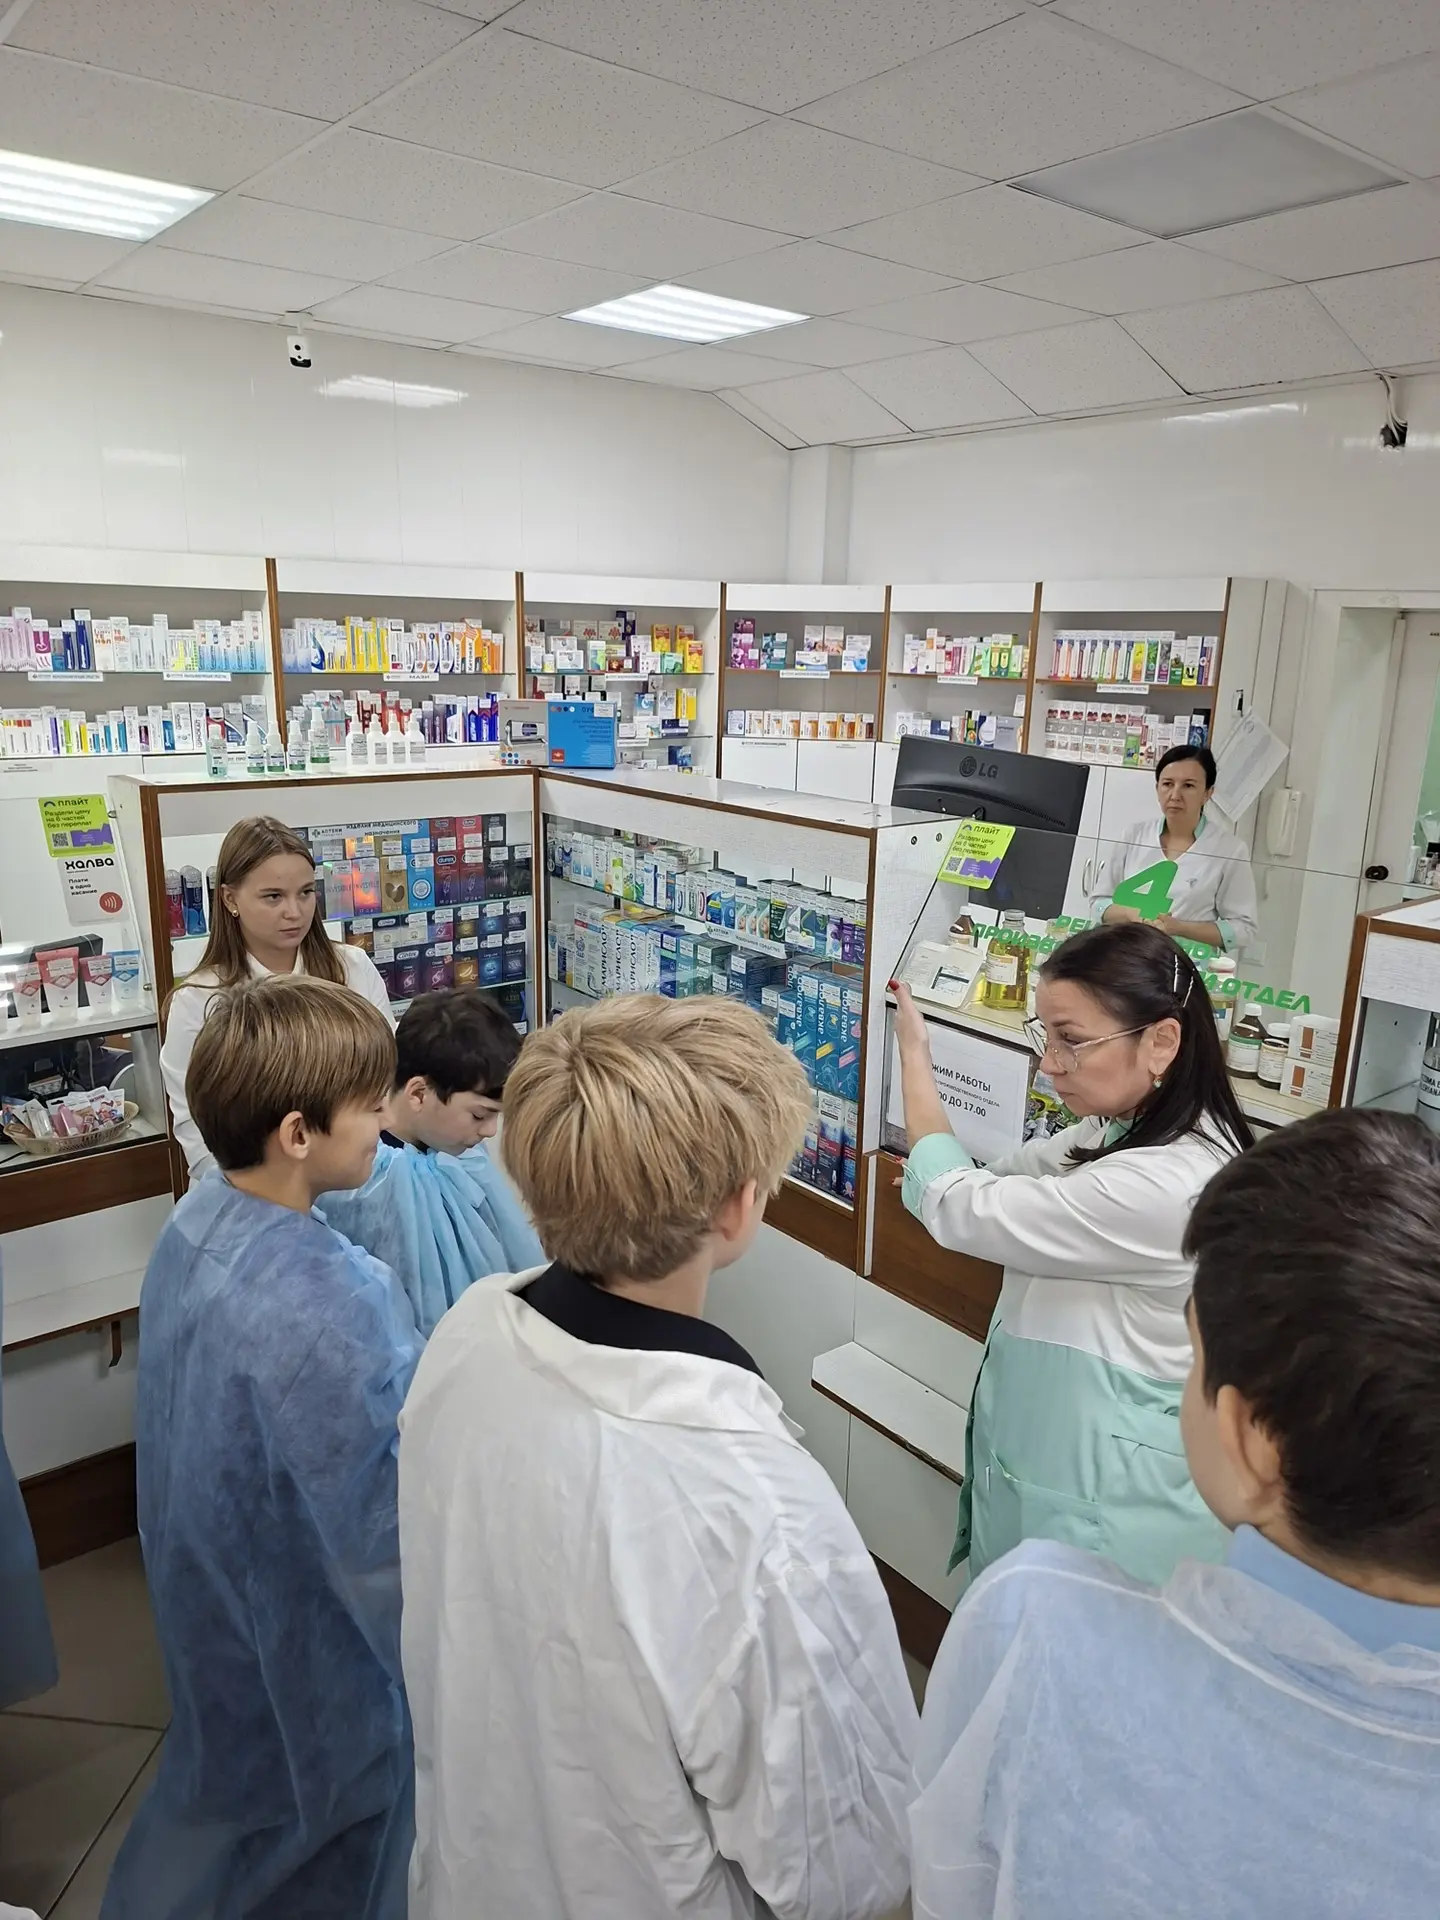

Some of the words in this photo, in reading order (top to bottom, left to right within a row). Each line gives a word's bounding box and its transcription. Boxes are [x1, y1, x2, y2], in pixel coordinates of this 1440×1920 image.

[978, 762, 999, 779] LG
[57, 798, 89, 807] плайт
[75, 808, 91, 816] цену
[974, 825, 1000, 835] плайт
[1112, 860, 1179, 921] 4
[972, 923, 1065, 955] ПРОИЗВ
[1222, 977, 1311, 1014] ОТДЕЛ
[840, 990, 849, 1043] аквалор
[932, 1063, 954, 1079] ЖИМ
[955, 1072, 991, 1092] РАБОТЫ
[948, 1096, 962, 1107] ДО
[963, 1102, 987, 1117] 17.00
